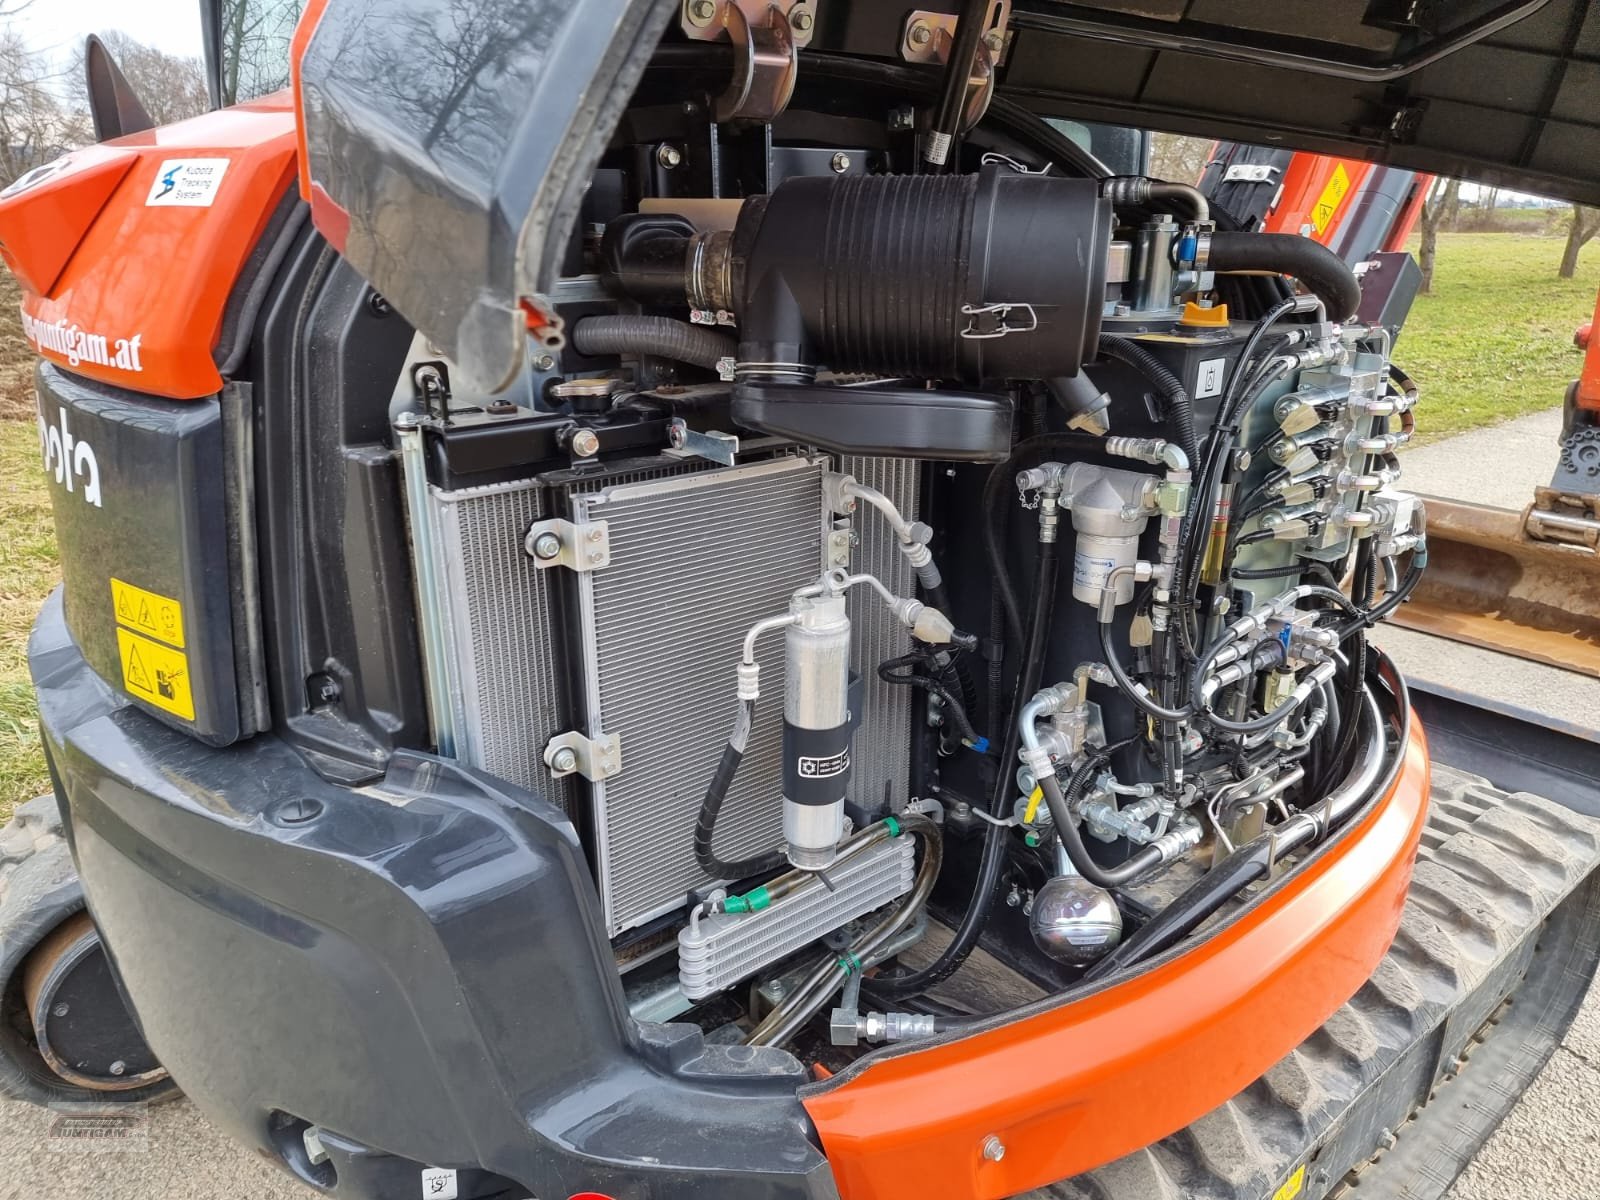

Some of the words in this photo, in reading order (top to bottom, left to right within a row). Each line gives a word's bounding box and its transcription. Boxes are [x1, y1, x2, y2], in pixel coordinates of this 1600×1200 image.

[186, 166, 214, 175] Kubota
[182, 177, 212, 189] Tracking
[175, 189, 203, 200] System
